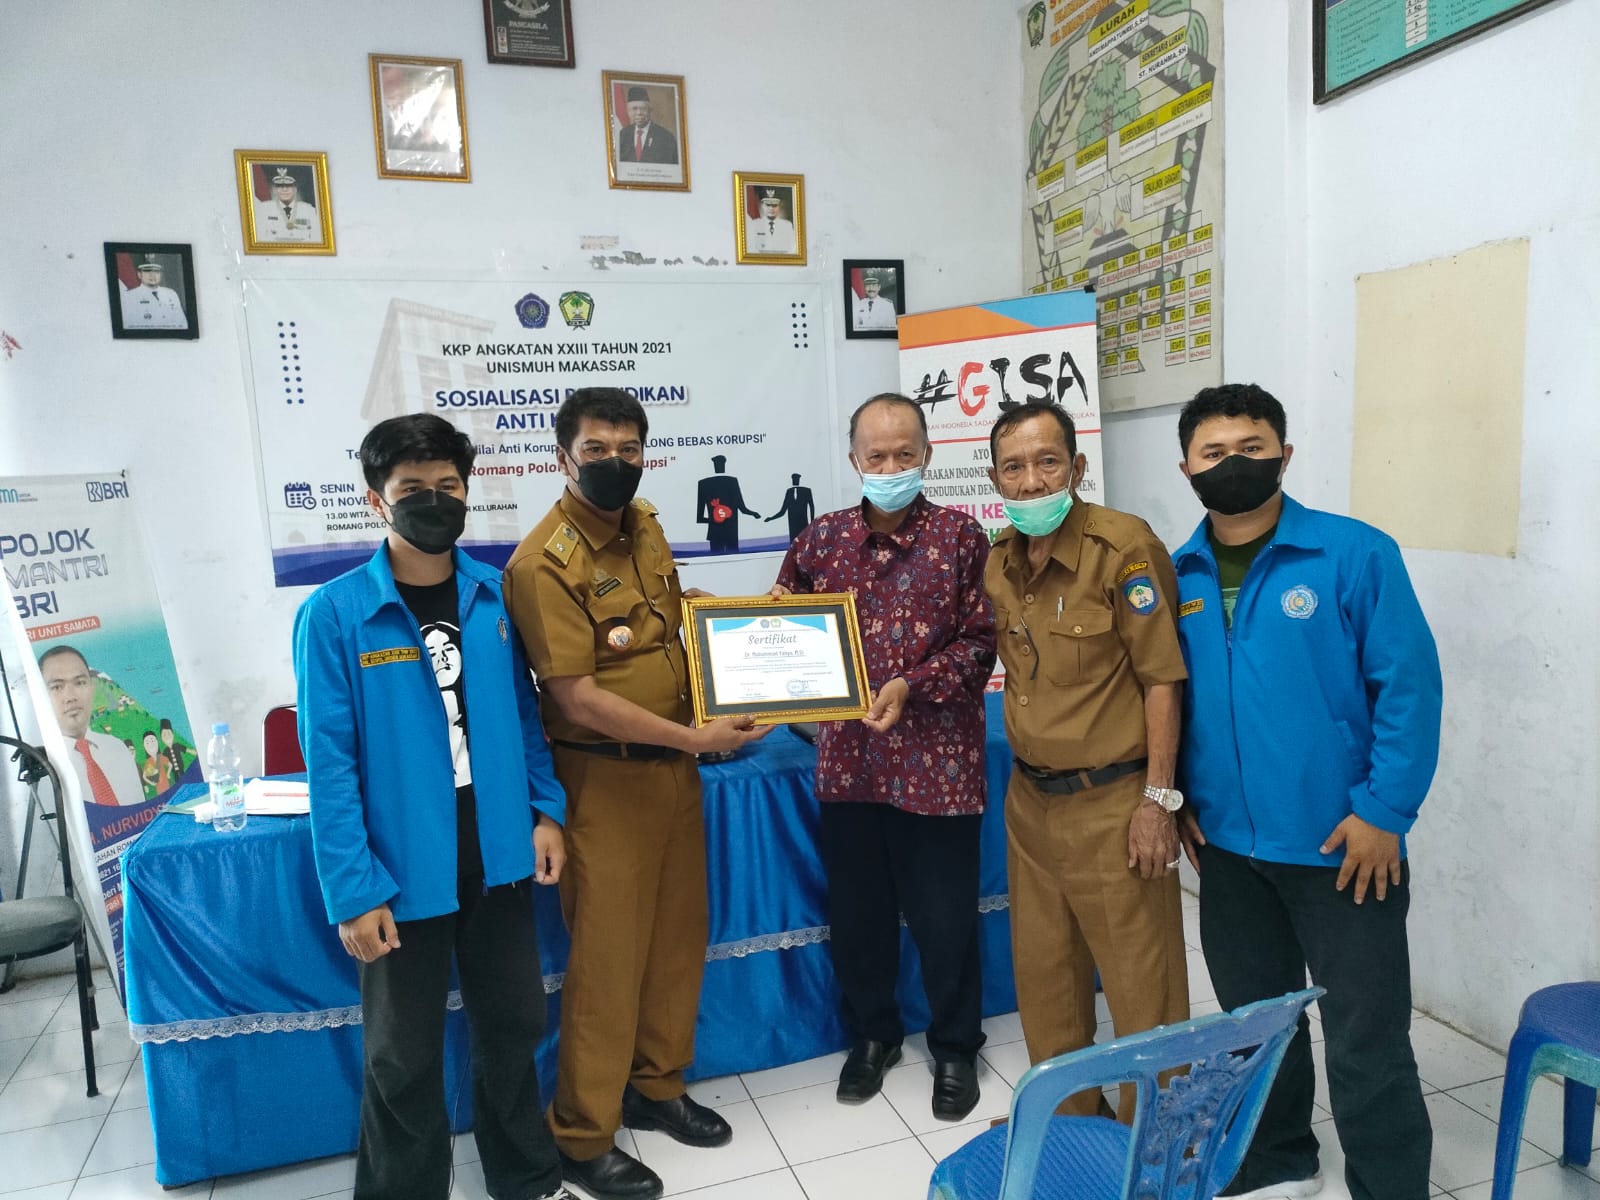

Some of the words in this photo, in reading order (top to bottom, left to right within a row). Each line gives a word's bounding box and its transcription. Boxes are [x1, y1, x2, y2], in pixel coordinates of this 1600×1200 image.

[1100, 5, 1135, 36] LURAH
[442, 344, 471, 356] KKP
[476, 344, 553, 355] ANGKATAN
[557, 343, 588, 354] XXIII
[592, 342, 638, 354] TAHUN
[642, 342, 671, 353] 2021
[487, 361, 554, 373] UNISMUH
[558, 360, 636, 372] MAKASSAR
[435, 388, 560, 407] SOSIALISASI
[496, 413, 545, 429] ANTI
[499, 444, 520, 454] Anti
[524, 443, 557, 454] Korup
[645, 438, 674, 448] LONG
[677, 436, 713, 446] BEBAS
[973, 448, 989, 460] AYO
[470, 464, 524, 477] Romang
[923, 467, 954, 480] ERAKAN
[102, 481, 129, 500] BRI
[320, 484, 355, 493] SENIN
[321, 498, 334, 507] 01
[327, 523, 363, 531] ROMANG
[0, 528, 94, 559] POJOK
[3, 554, 109, 589] MANTRI
[39, 625, 62, 639] UNIT
[64, 618, 97, 633] SAMATA
[748, 633, 797, 646] Sertifikat
